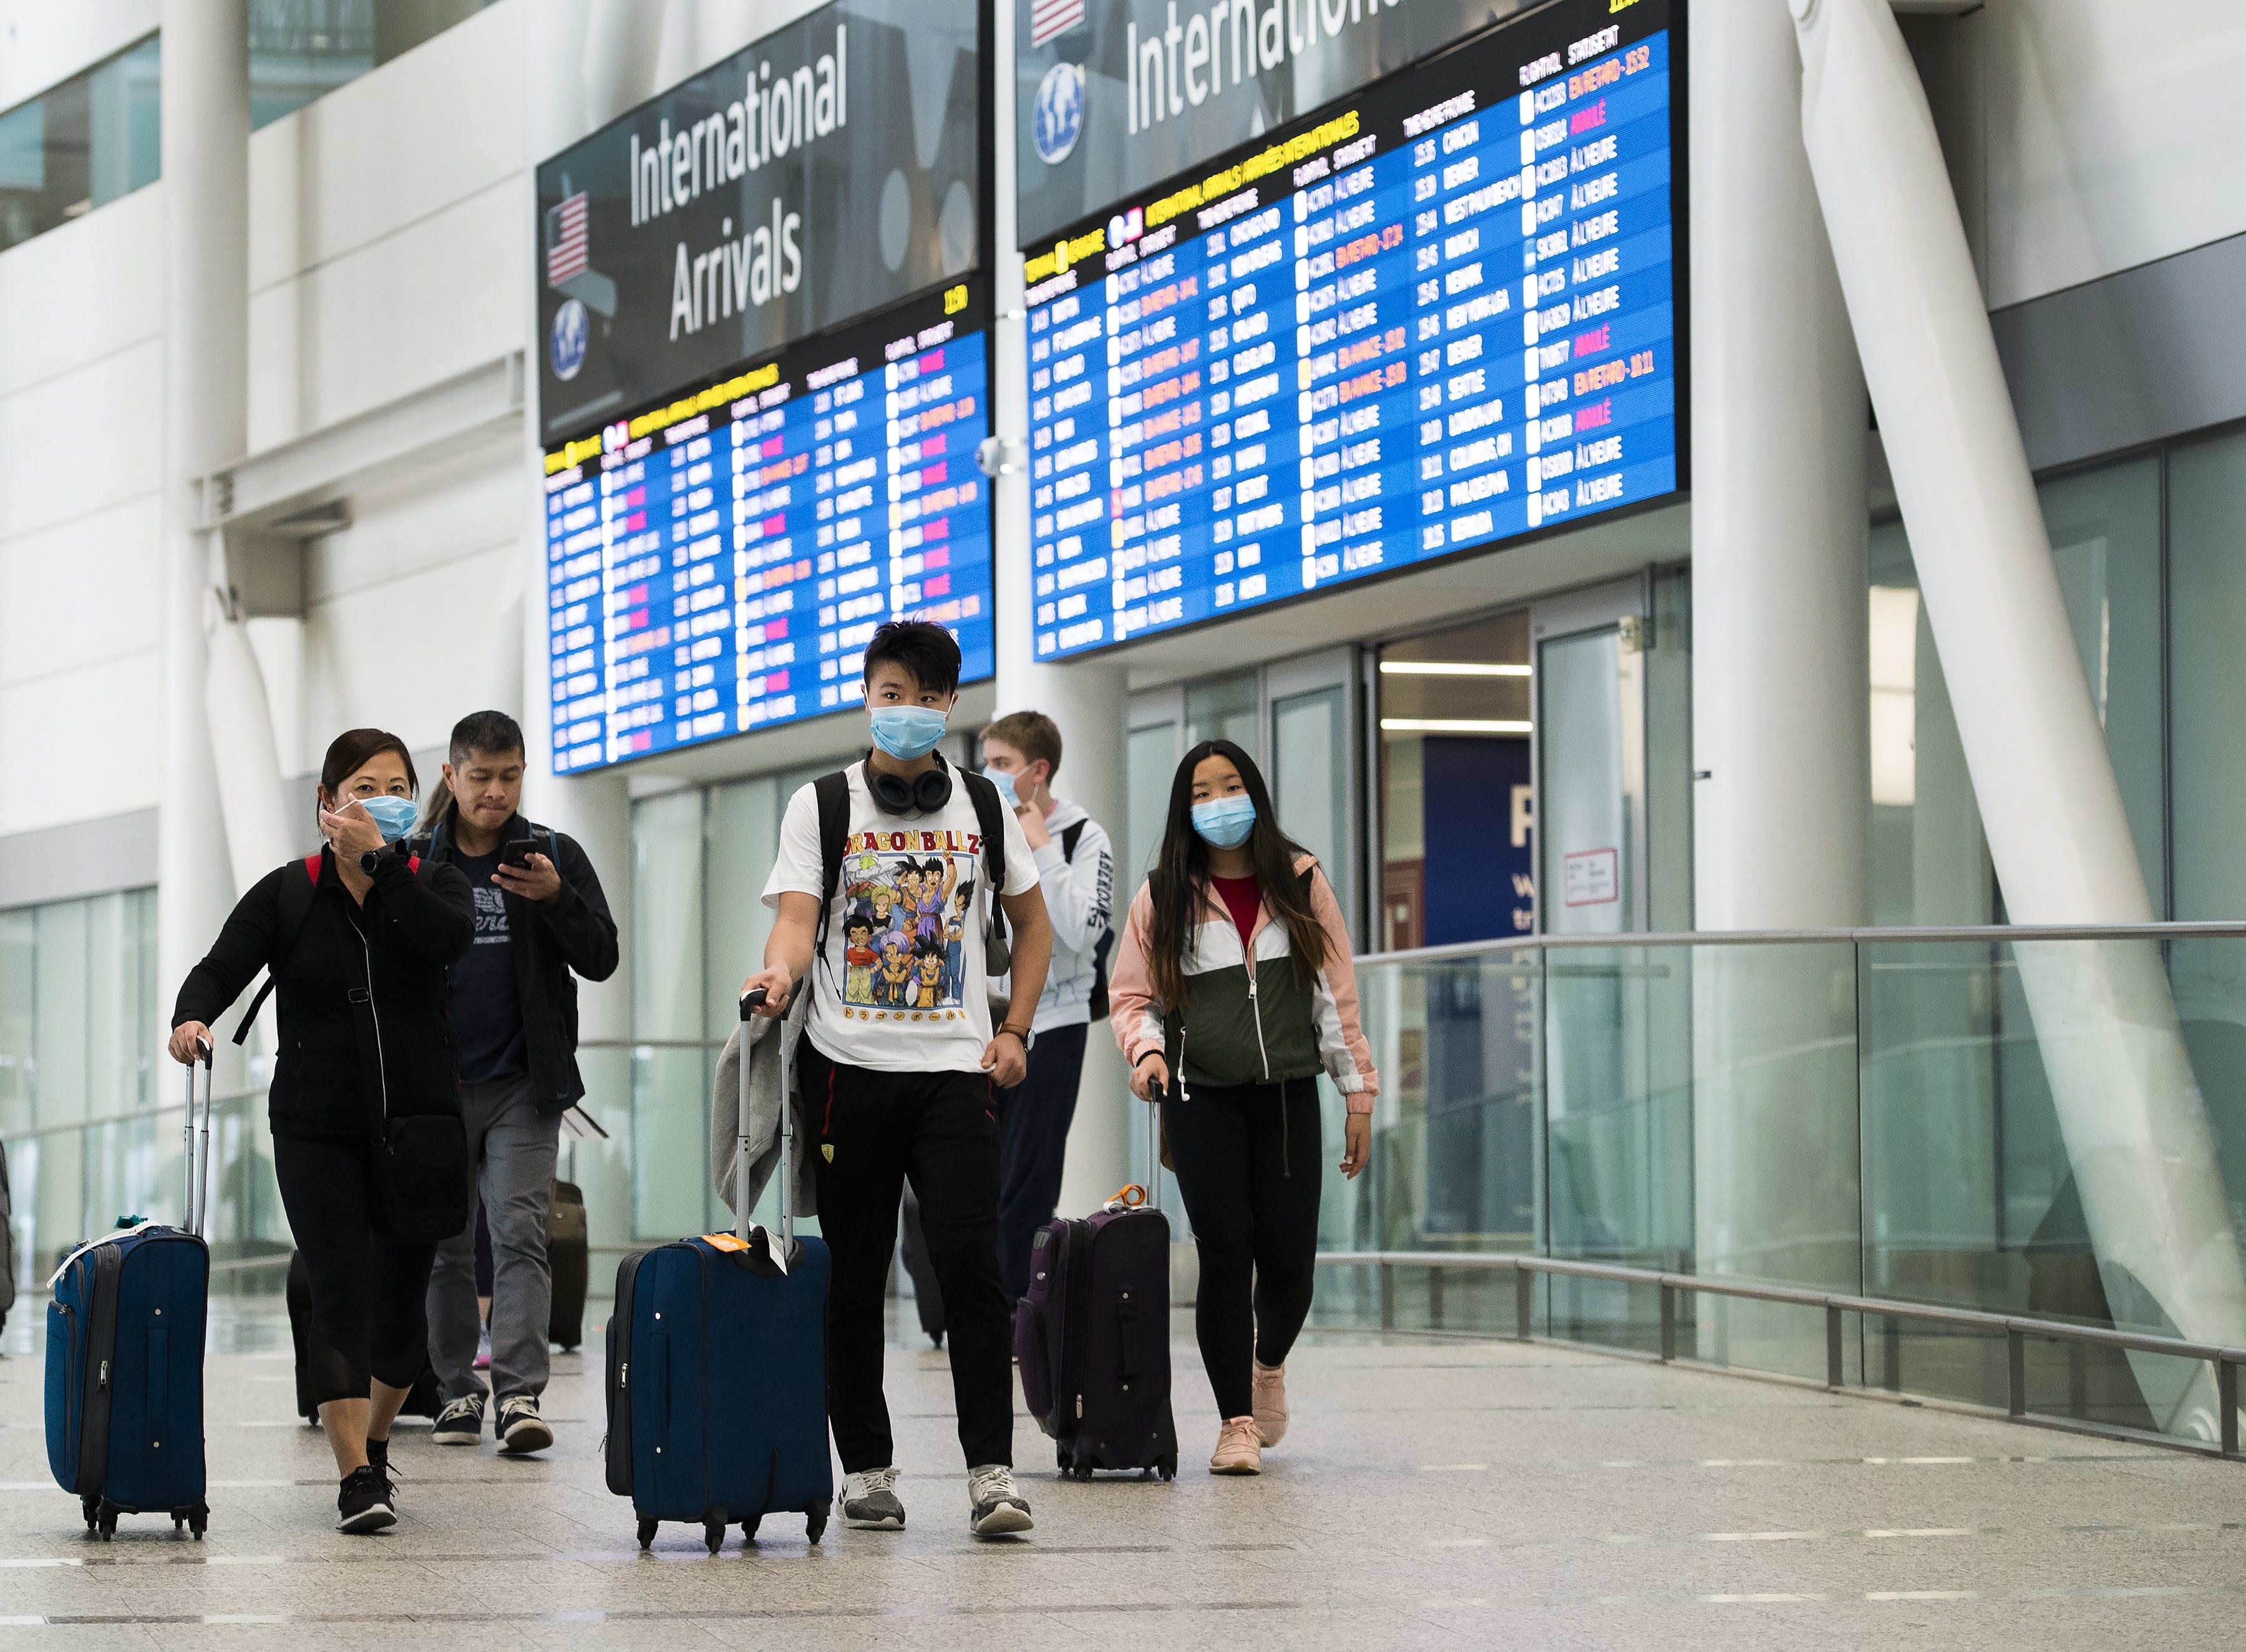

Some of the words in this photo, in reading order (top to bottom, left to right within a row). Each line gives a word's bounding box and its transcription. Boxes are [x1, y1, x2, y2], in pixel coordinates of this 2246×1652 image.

[631, 23, 847, 228] International
[670, 197, 802, 343] Arrivals
[921, 830, 967, 851] BALL
[967, 833, 980, 855] Z
